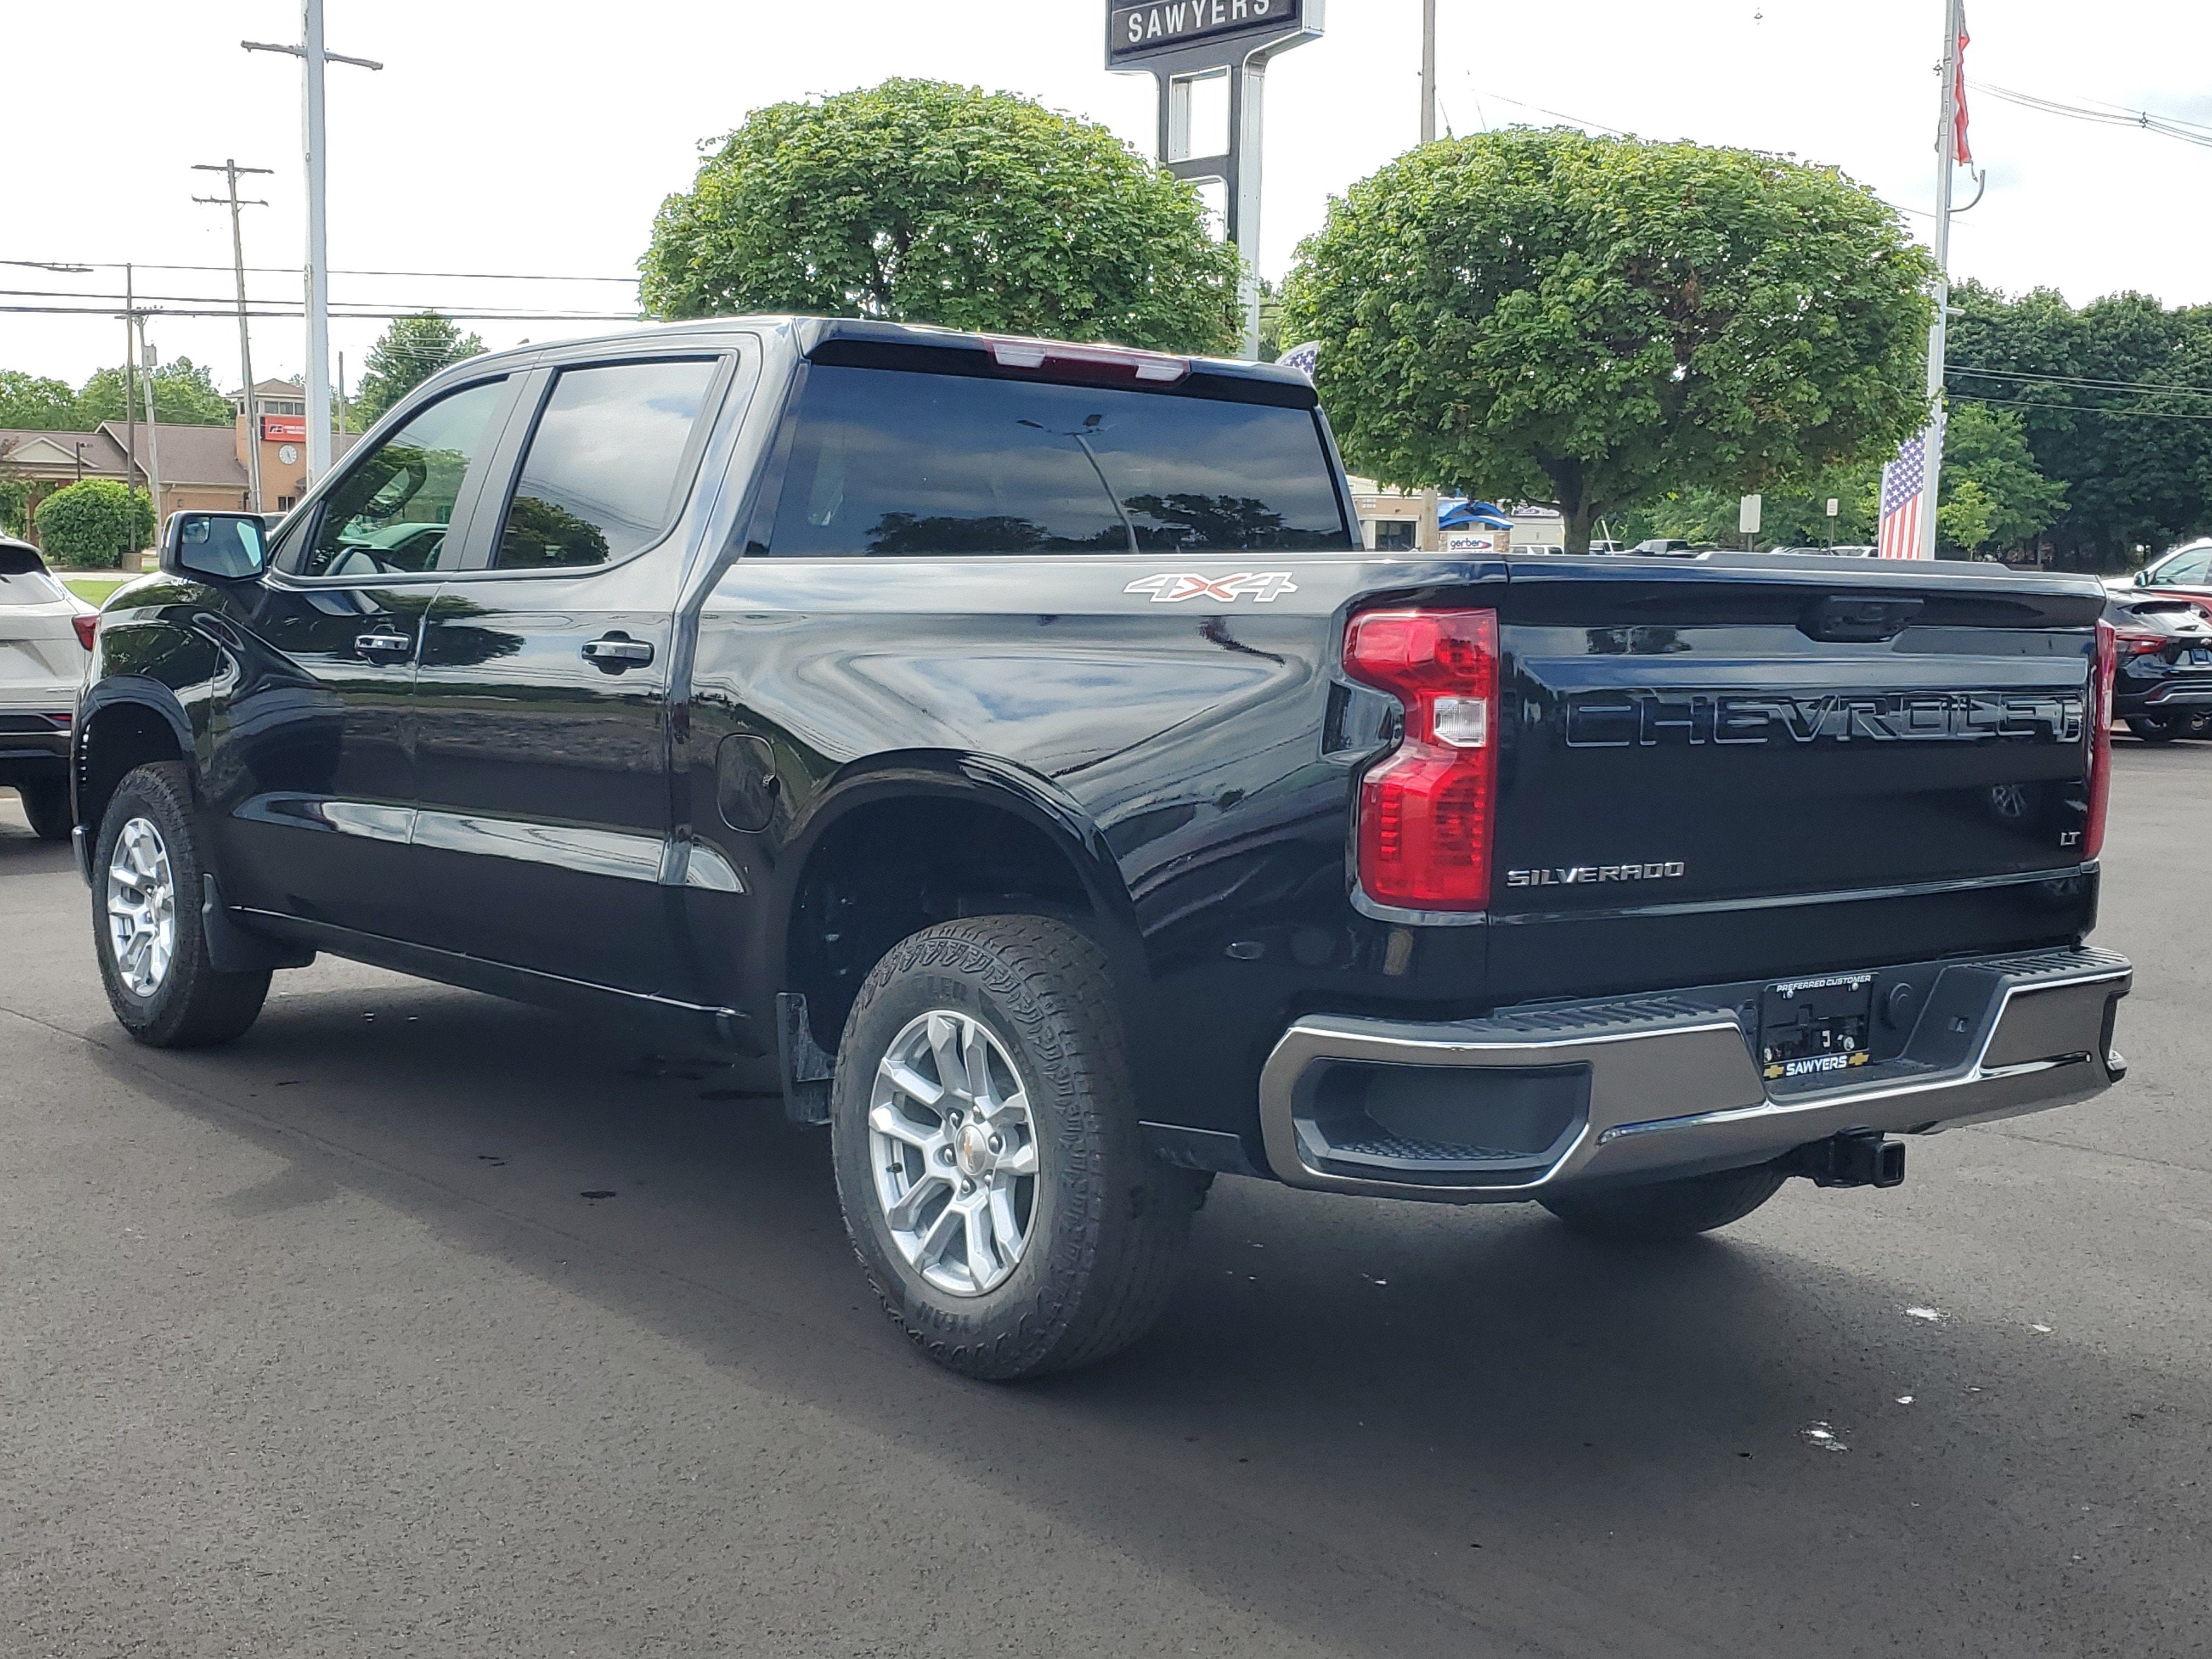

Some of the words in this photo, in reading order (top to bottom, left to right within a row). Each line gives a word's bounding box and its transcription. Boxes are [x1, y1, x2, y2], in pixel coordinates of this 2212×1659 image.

[1127, 0, 1269, 42] SAWYERS
[1450, 537, 1482, 550] gerber
[1566, 692, 2084, 747] CHEVROLET
[2060, 831, 2081, 845] LT
[1507, 862, 1685, 887] SILVERADO
[1776, 980, 1826, 992] PREFERRED
[1826, 975, 1871, 985] CUSTOMER
[1786, 1055, 1848, 1076] SAWYERS
